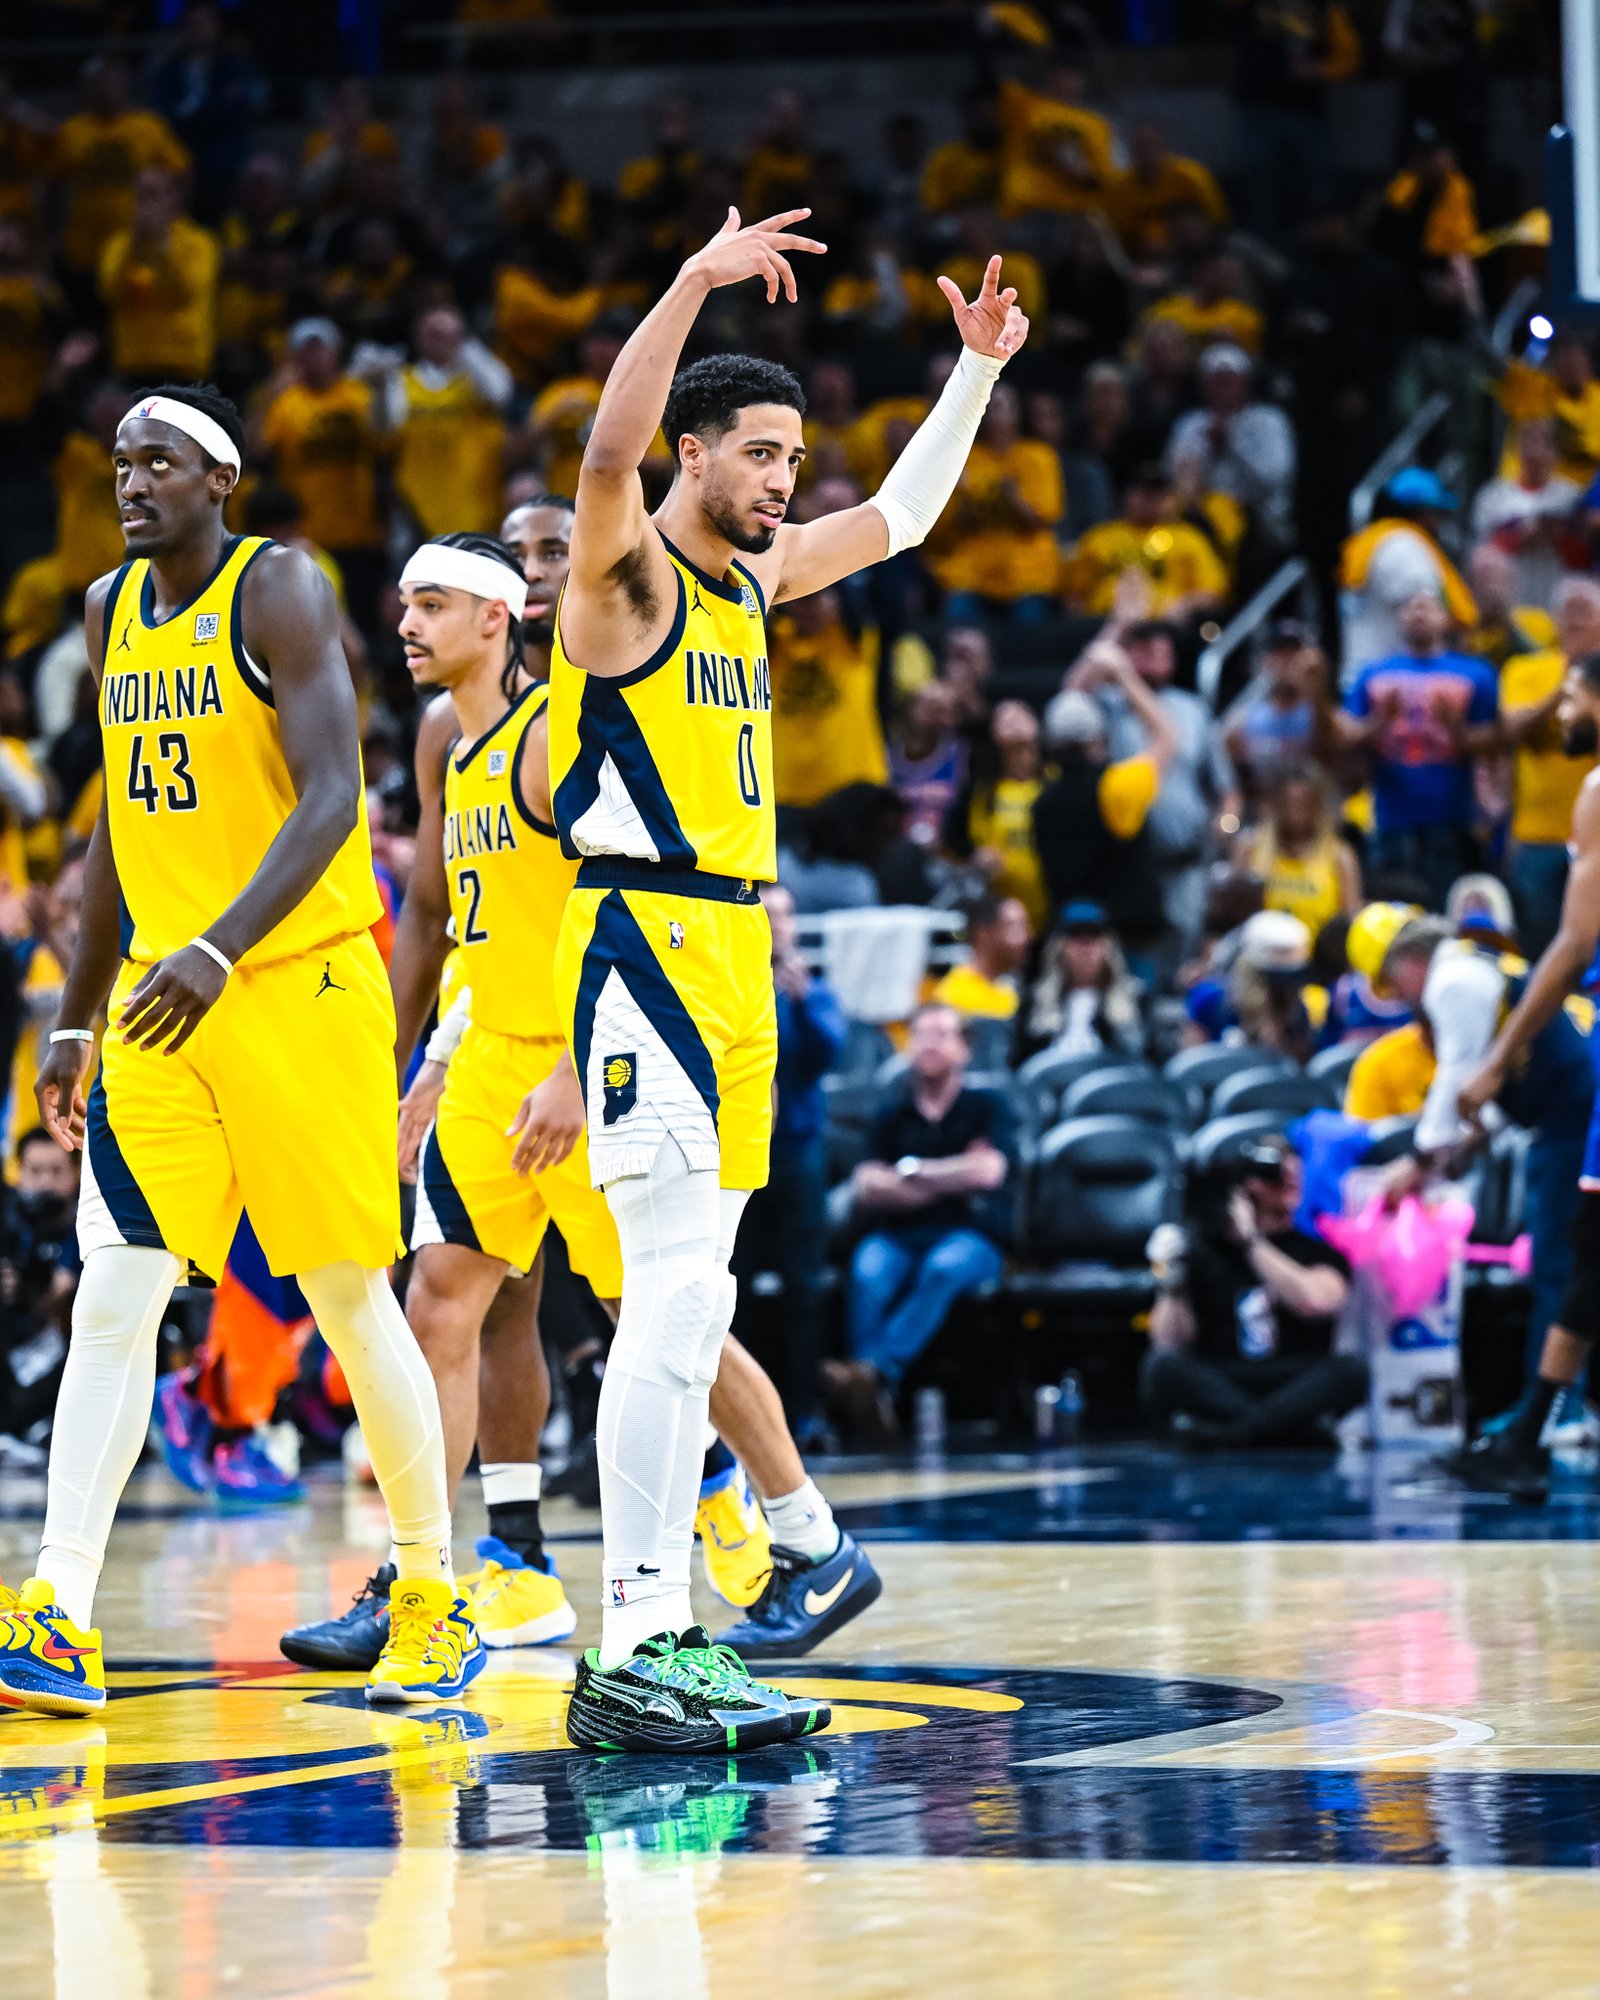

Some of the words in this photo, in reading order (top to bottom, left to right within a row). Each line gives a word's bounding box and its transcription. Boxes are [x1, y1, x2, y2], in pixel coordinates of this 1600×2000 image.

[104, 664, 224, 726] INDIANA
[127, 732, 199, 814] 43
[737, 722, 762, 807] 0
[458, 869, 488, 944] 2
